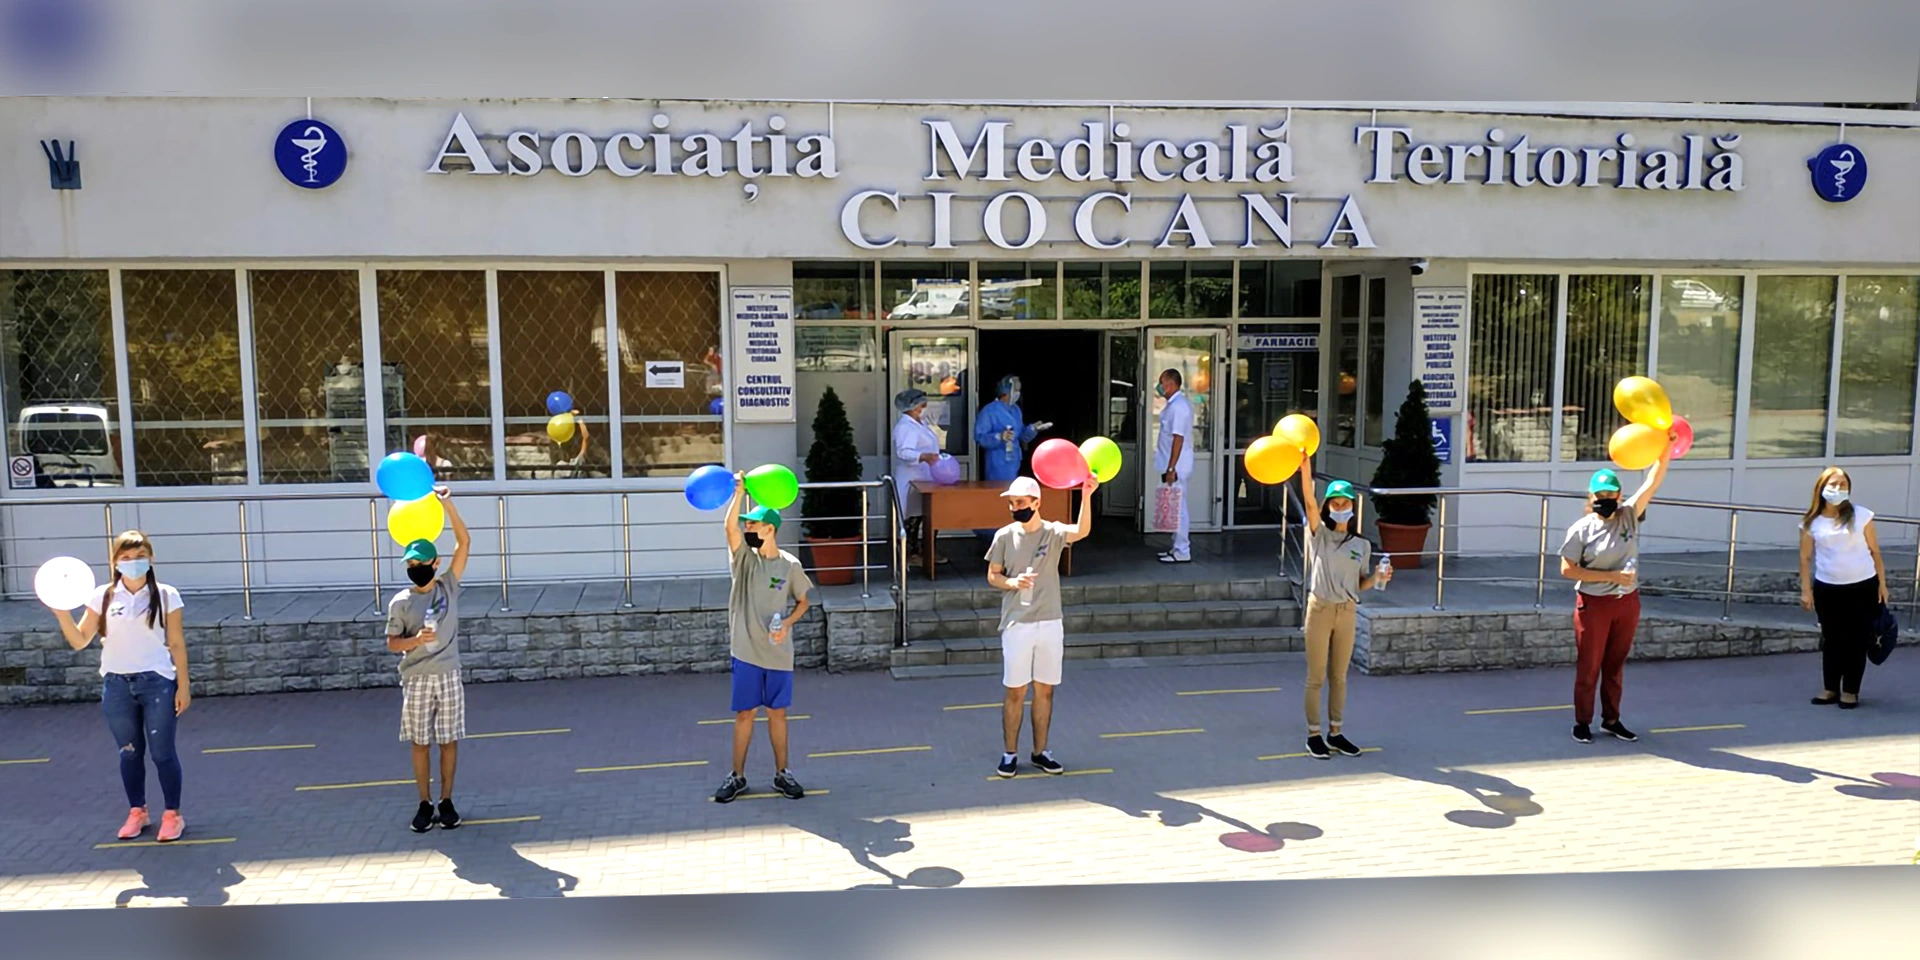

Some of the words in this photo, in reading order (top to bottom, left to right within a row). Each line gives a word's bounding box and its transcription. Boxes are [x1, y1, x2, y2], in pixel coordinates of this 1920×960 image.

[426, 111, 840, 202] Asociația
[921, 119, 1297, 183] Medicală
[1354, 125, 1746, 192] Teritorială
[840, 191, 1378, 251] CIOCANA
[1255, 338, 1317, 346] FARMACIE
[746, 375, 782, 384] CENTRUL
[737, 386, 792, 396] CONSULTATIV
[740, 397, 790, 408] DIAGNOSTIC
